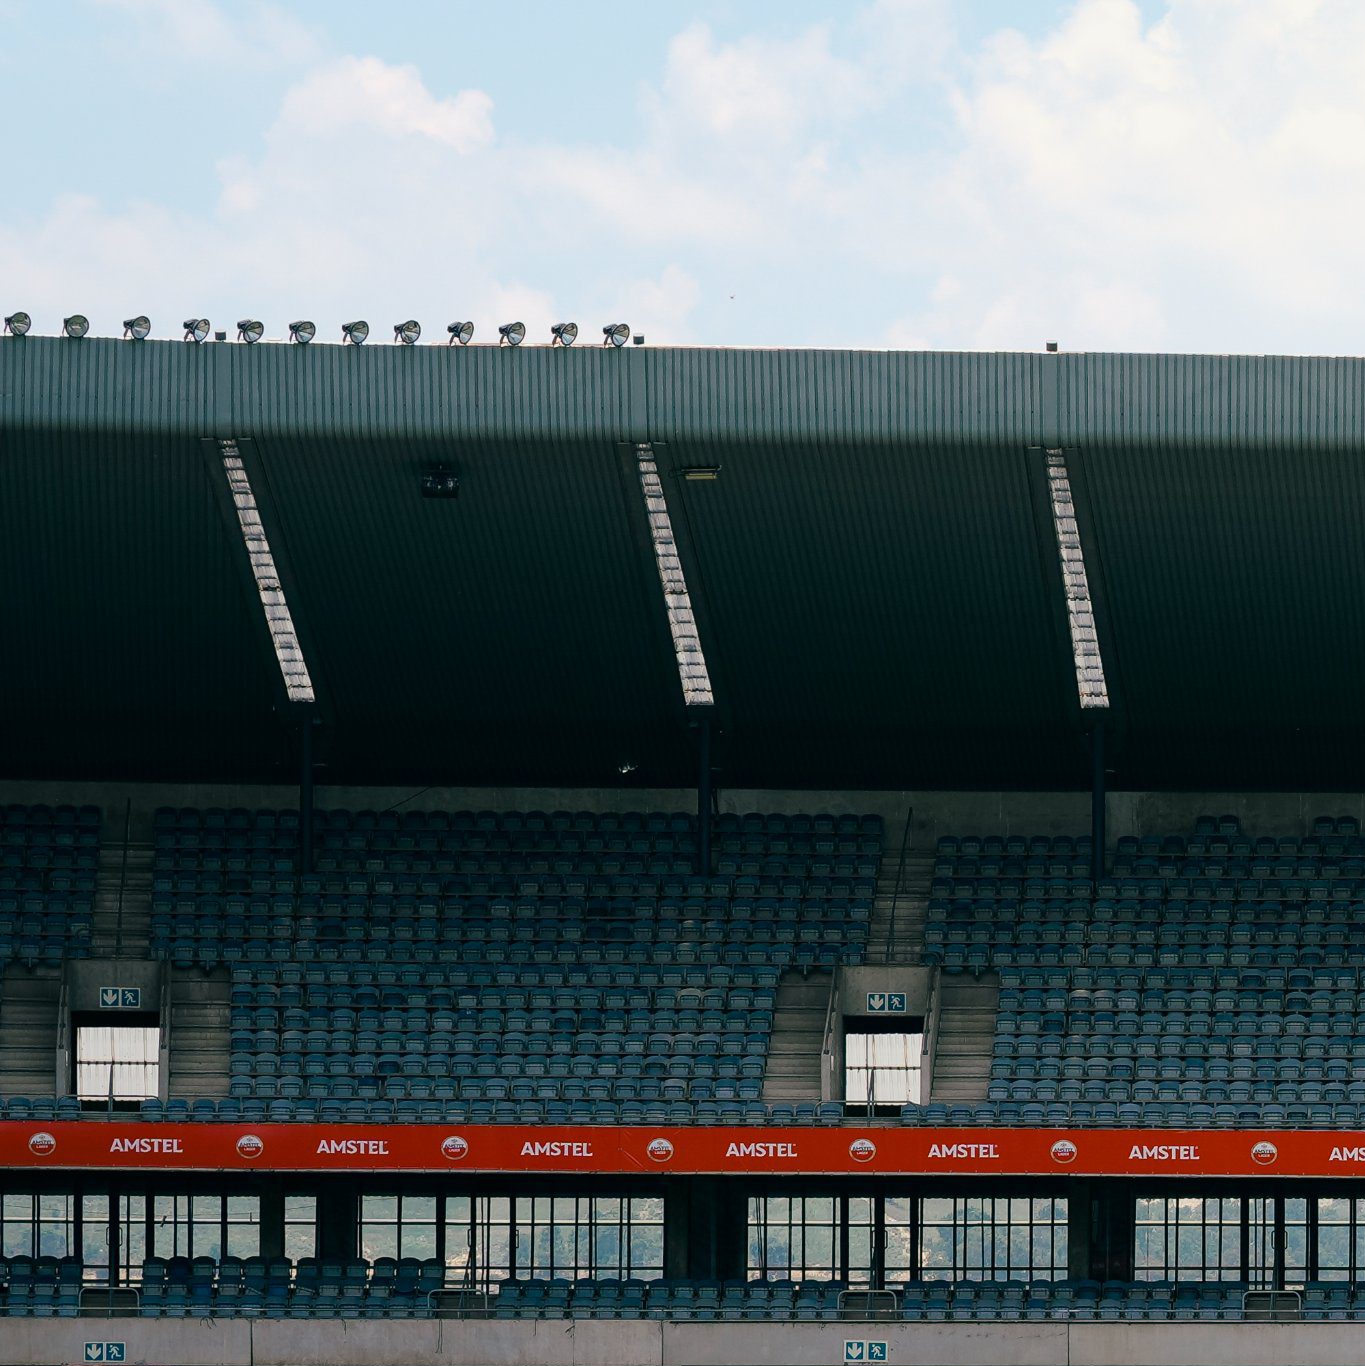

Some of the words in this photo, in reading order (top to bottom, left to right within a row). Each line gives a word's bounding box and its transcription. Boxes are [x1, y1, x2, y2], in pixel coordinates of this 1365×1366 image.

[110, 1138, 183, 1152] AMSTEL
[317, 1140, 389, 1155] AMSTEL
[521, 1142, 593, 1156] AMSTEL
[726, 1143, 798, 1157] AMSTEL
[928, 1144, 1000, 1158] AMSTEL
[1129, 1146, 1200, 1160] AMSTEL
